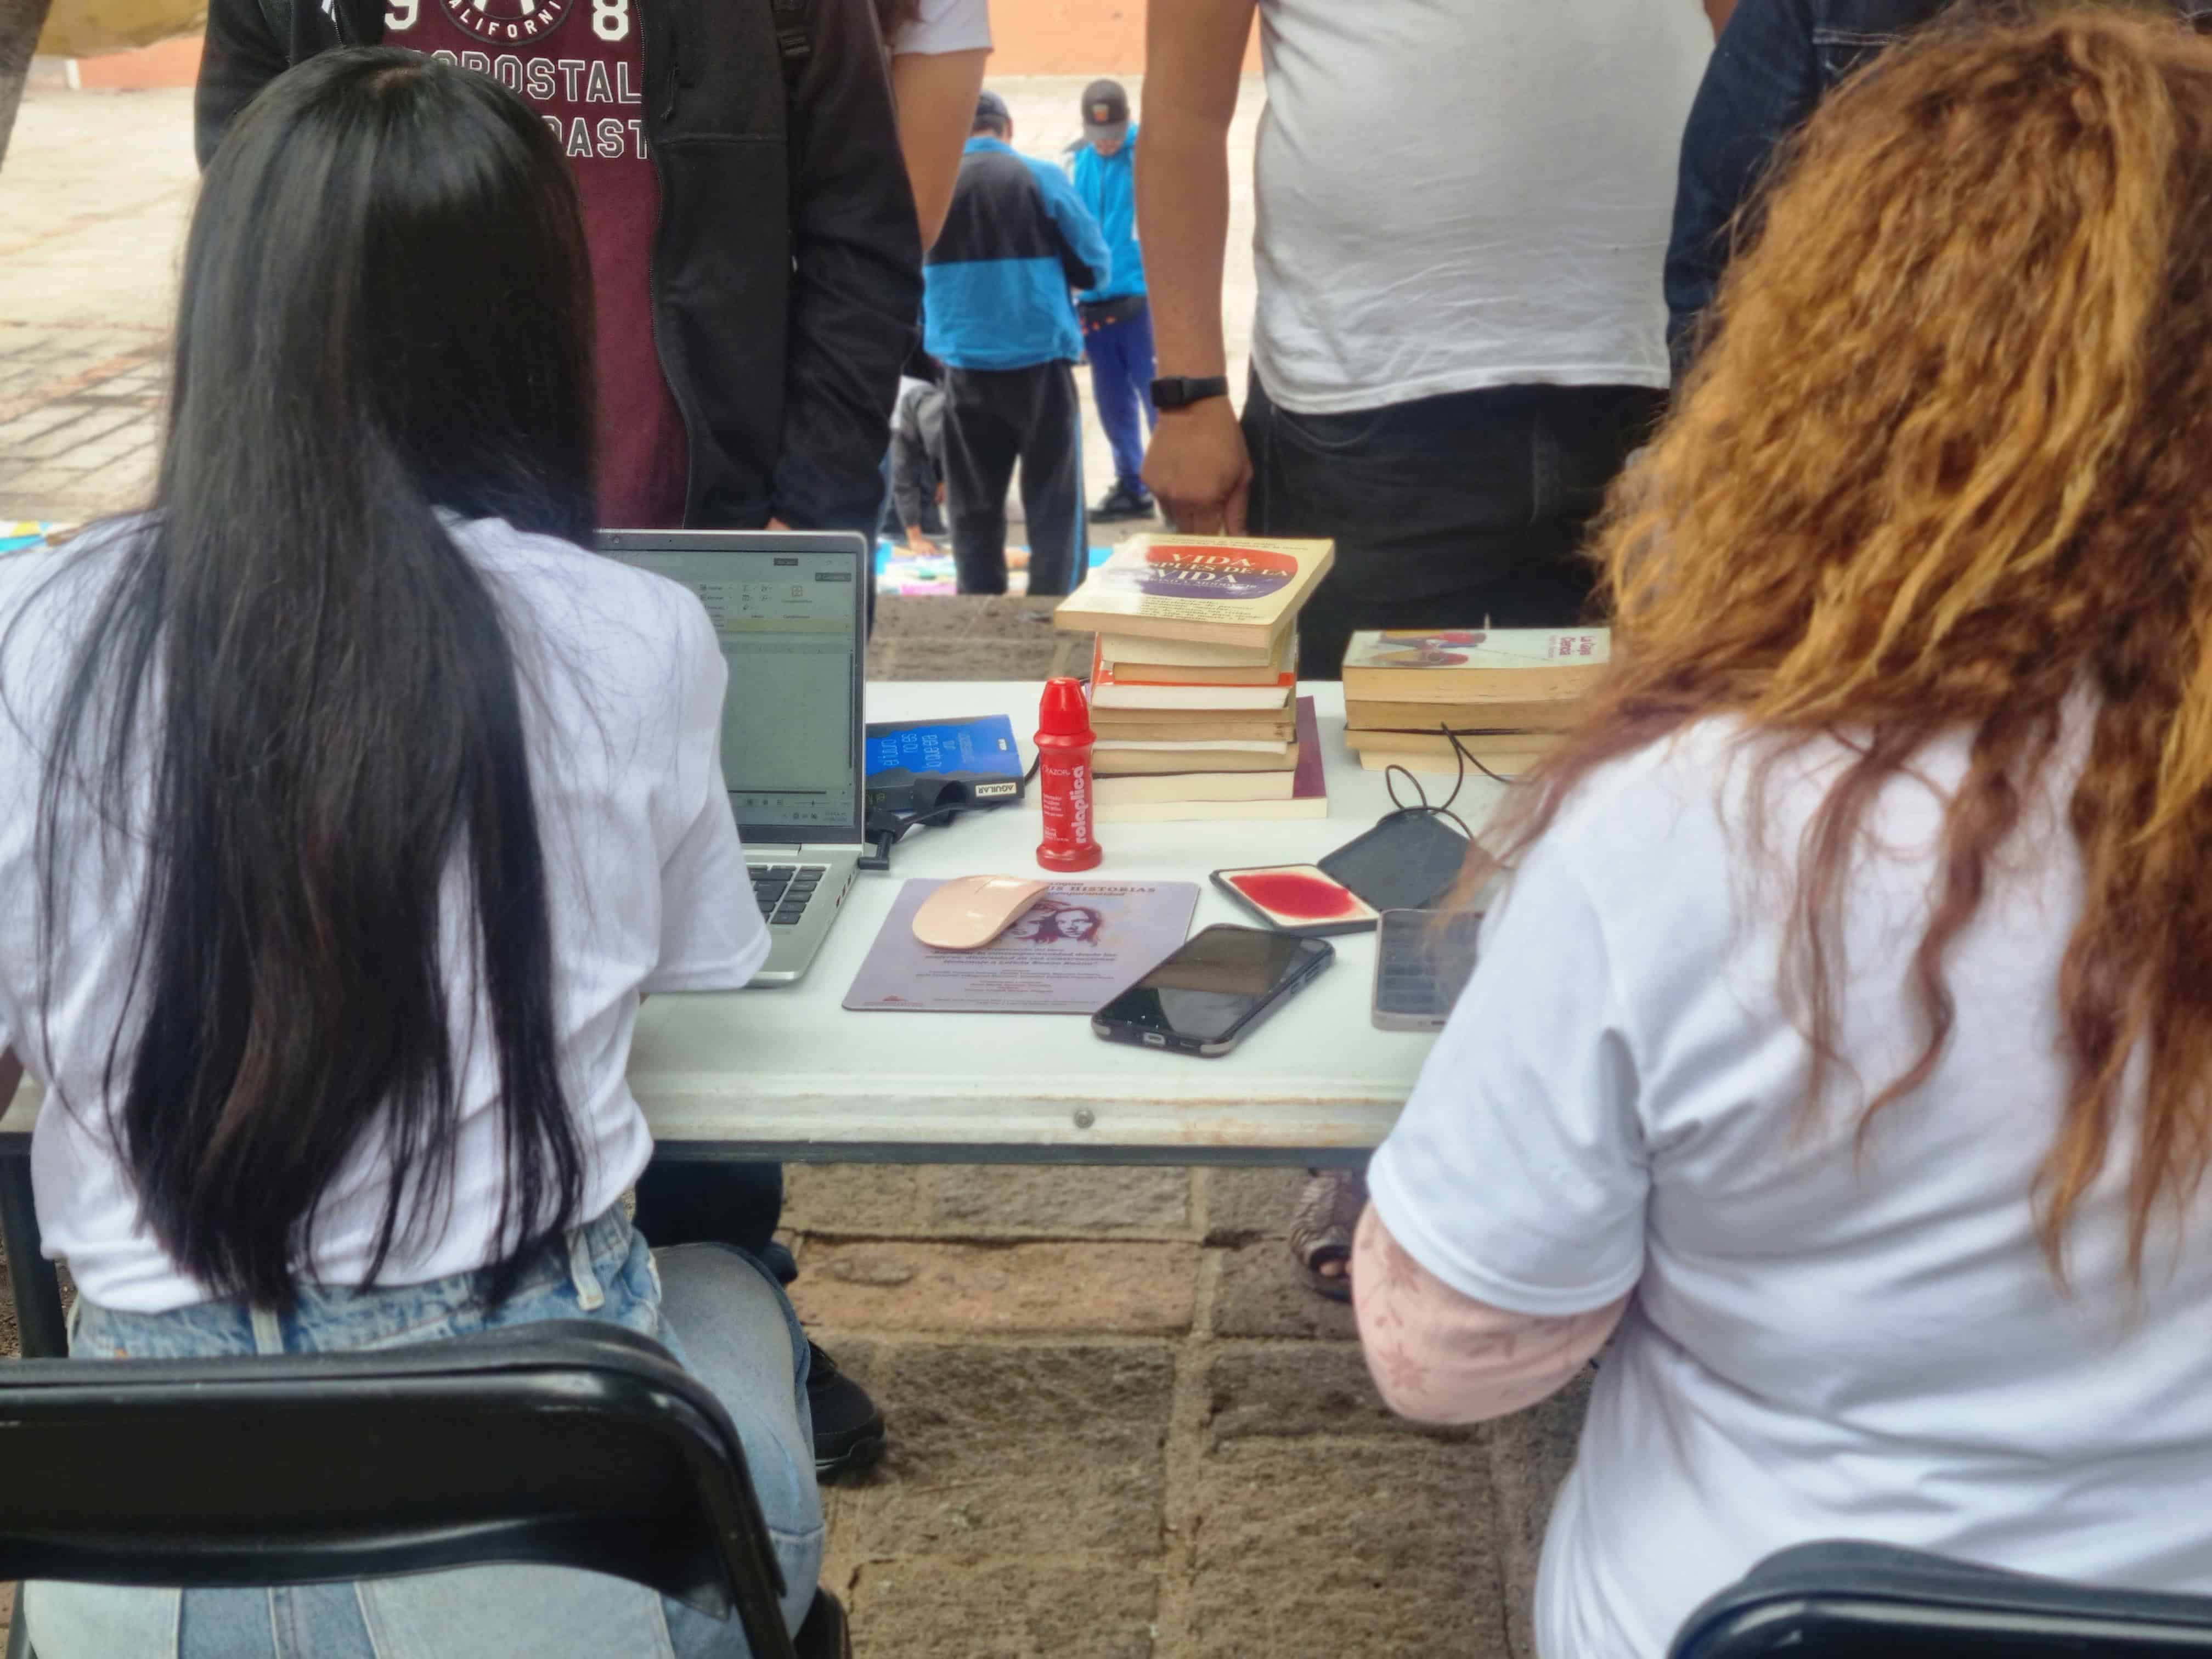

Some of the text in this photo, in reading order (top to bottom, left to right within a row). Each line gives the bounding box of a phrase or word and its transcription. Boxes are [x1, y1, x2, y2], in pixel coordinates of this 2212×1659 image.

[448, 0, 561, 38] ALIFORNI
[1172, 553, 1256, 567] VIDA
[1158, 569, 1237, 583] VIDA
[978, 785, 1014, 794] AGUILAR
[1070, 765, 1089, 844] rolaplica
